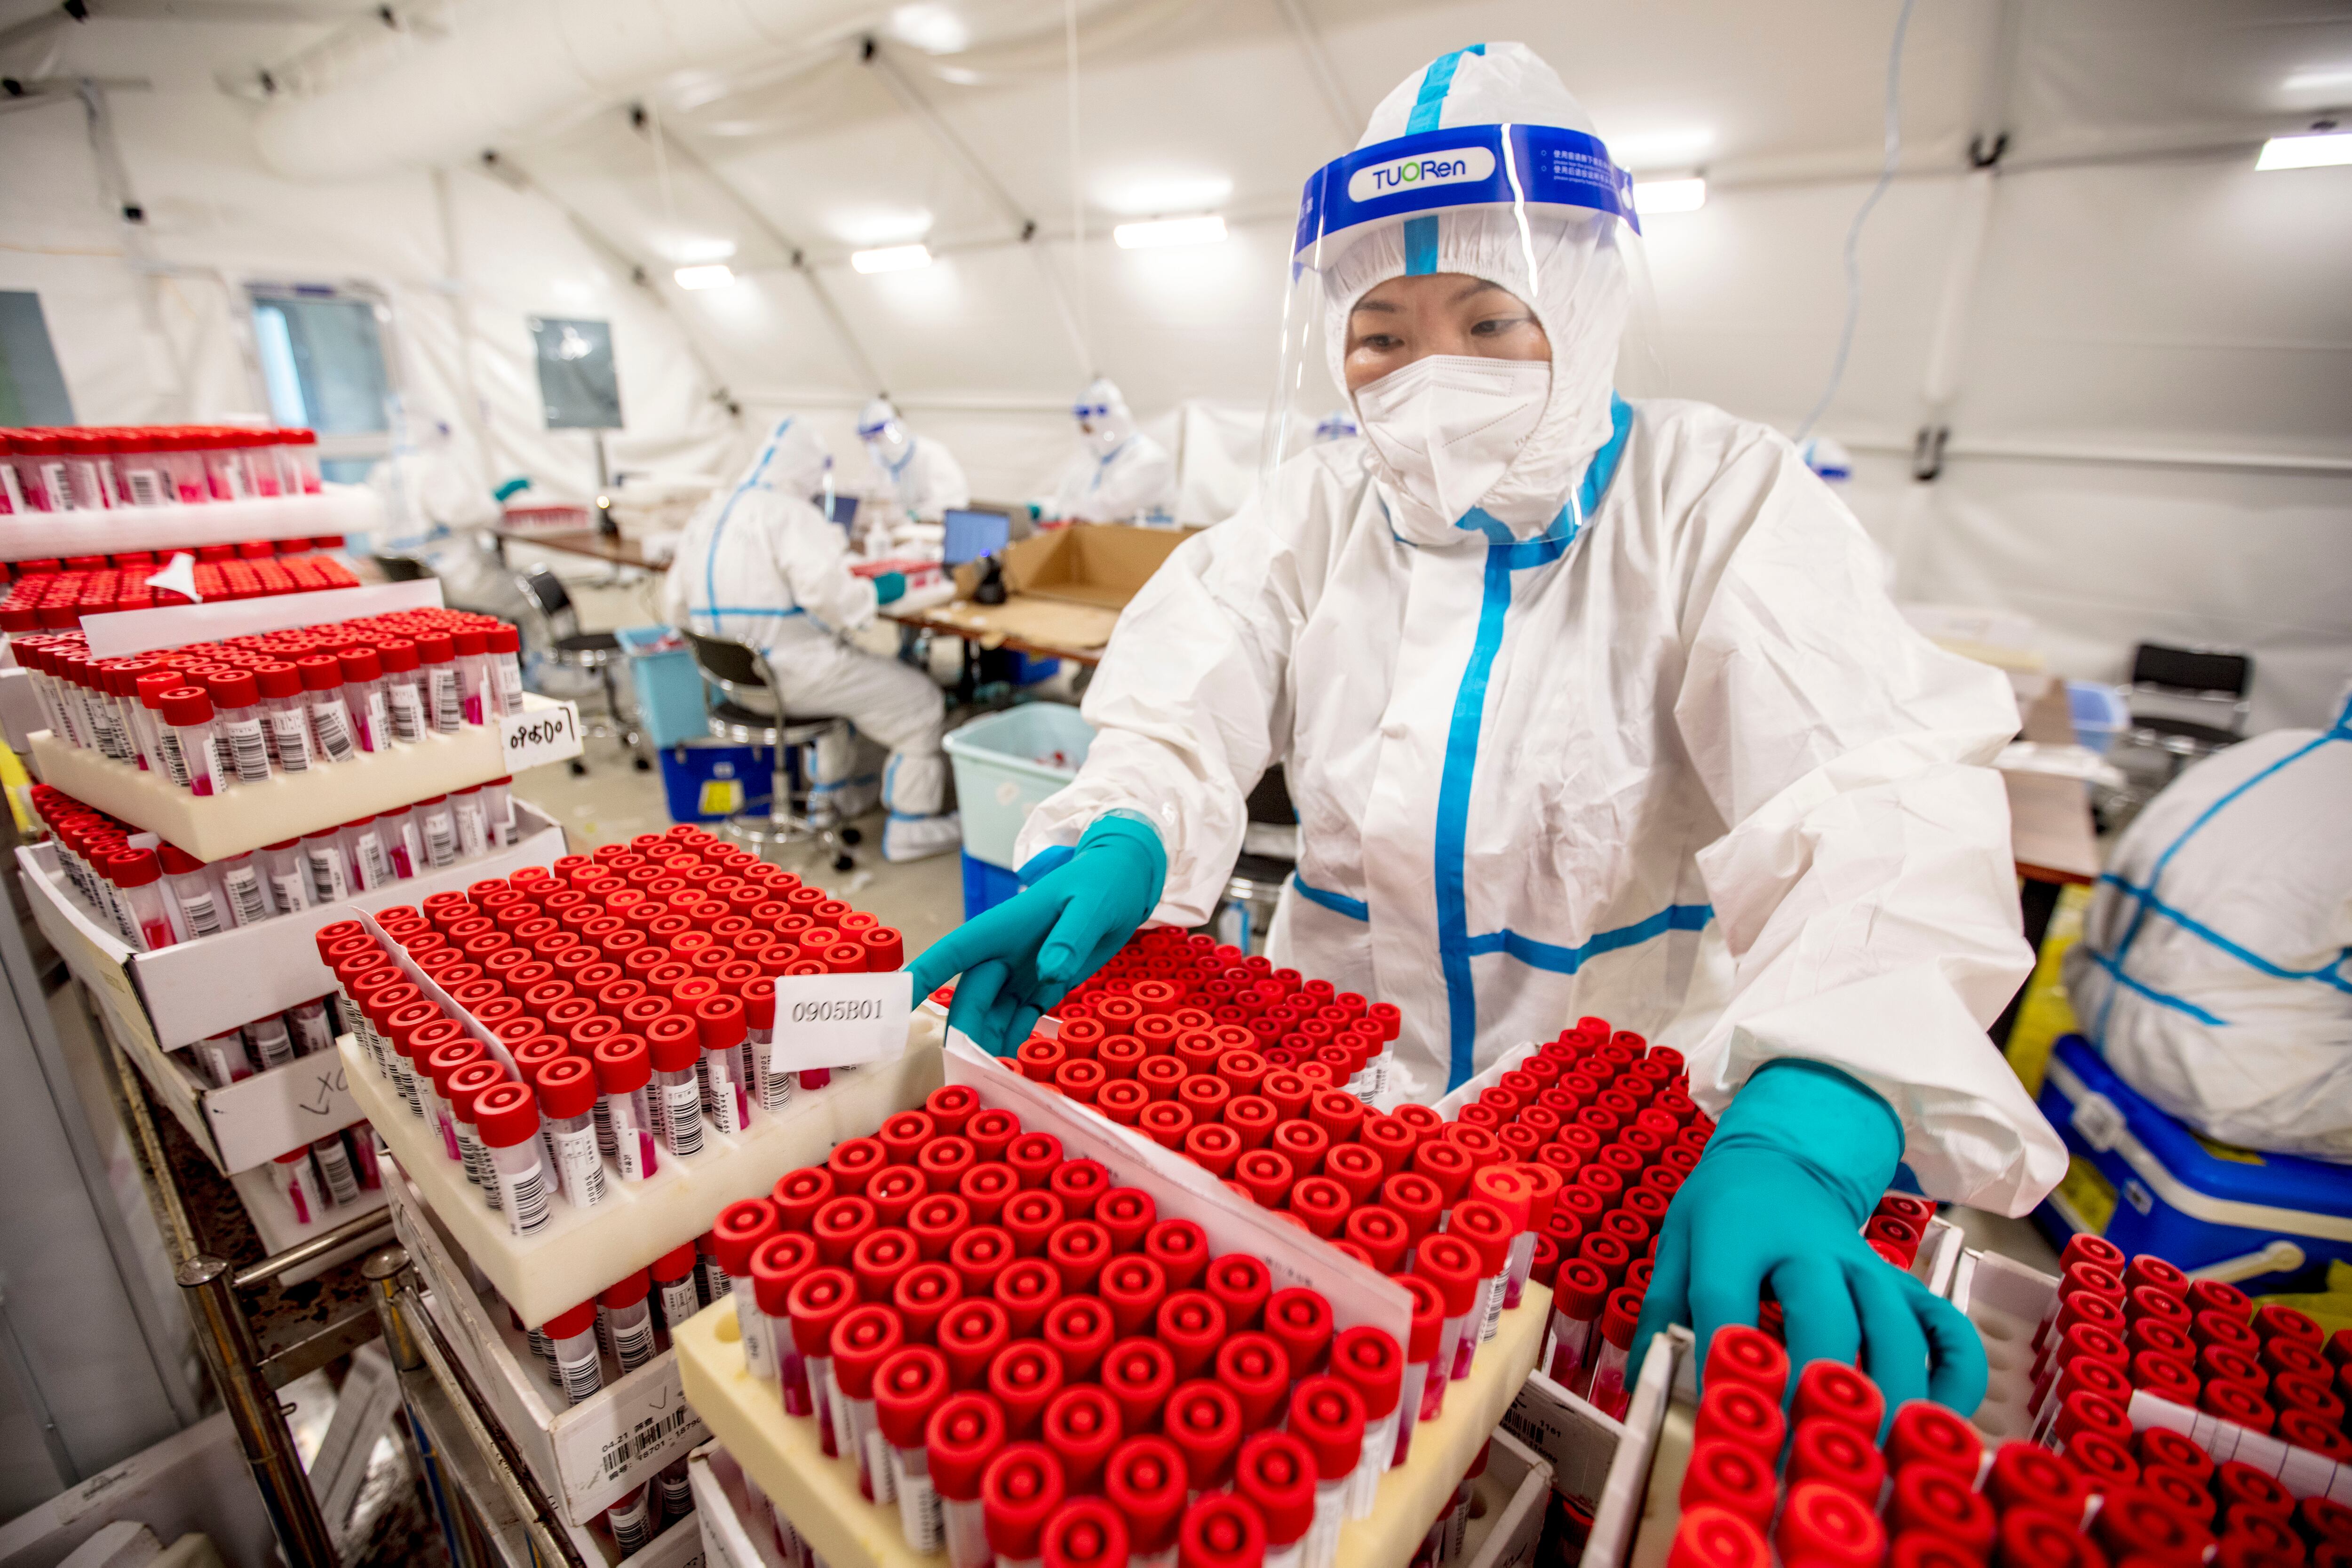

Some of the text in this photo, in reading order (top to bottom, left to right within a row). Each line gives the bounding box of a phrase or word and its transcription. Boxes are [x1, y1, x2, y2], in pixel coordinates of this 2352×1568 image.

[1372, 159, 1466, 190] TUORen
[792, 999, 883, 1023] 0905B01
[602, 1433, 628, 1453] 04.21
[638, 1441, 666, 1461] 18701
